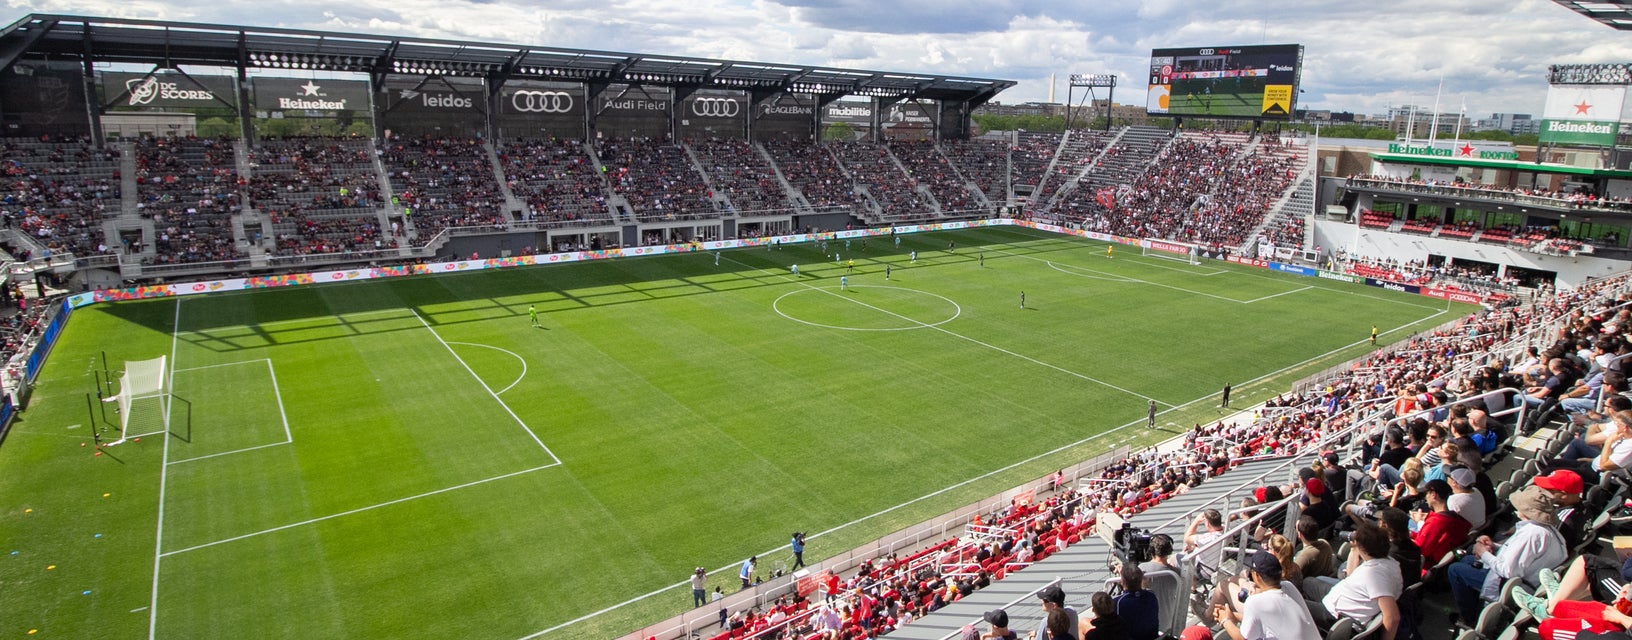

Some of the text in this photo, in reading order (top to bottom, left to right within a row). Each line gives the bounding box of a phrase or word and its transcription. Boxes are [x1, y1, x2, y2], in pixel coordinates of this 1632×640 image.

[160, 82, 176, 91] DC
[161, 90, 213, 100] SCORES
[279, 97, 345, 110] Heineken
[422, 93, 472, 108] leidos
[604, 100, 666, 110] Audi Field
[829, 107, 872, 116] mobilitie
[1548, 120, 1612, 134] Heineken
[1388, 144, 1519, 160] Heineken ROOFTOP
[1152, 242, 1168, 250] WELLS
[1318, 271, 1353, 283] Heineken
[1384, 282, 1406, 292] leidos
[1428, 290, 1444, 298] Audi
